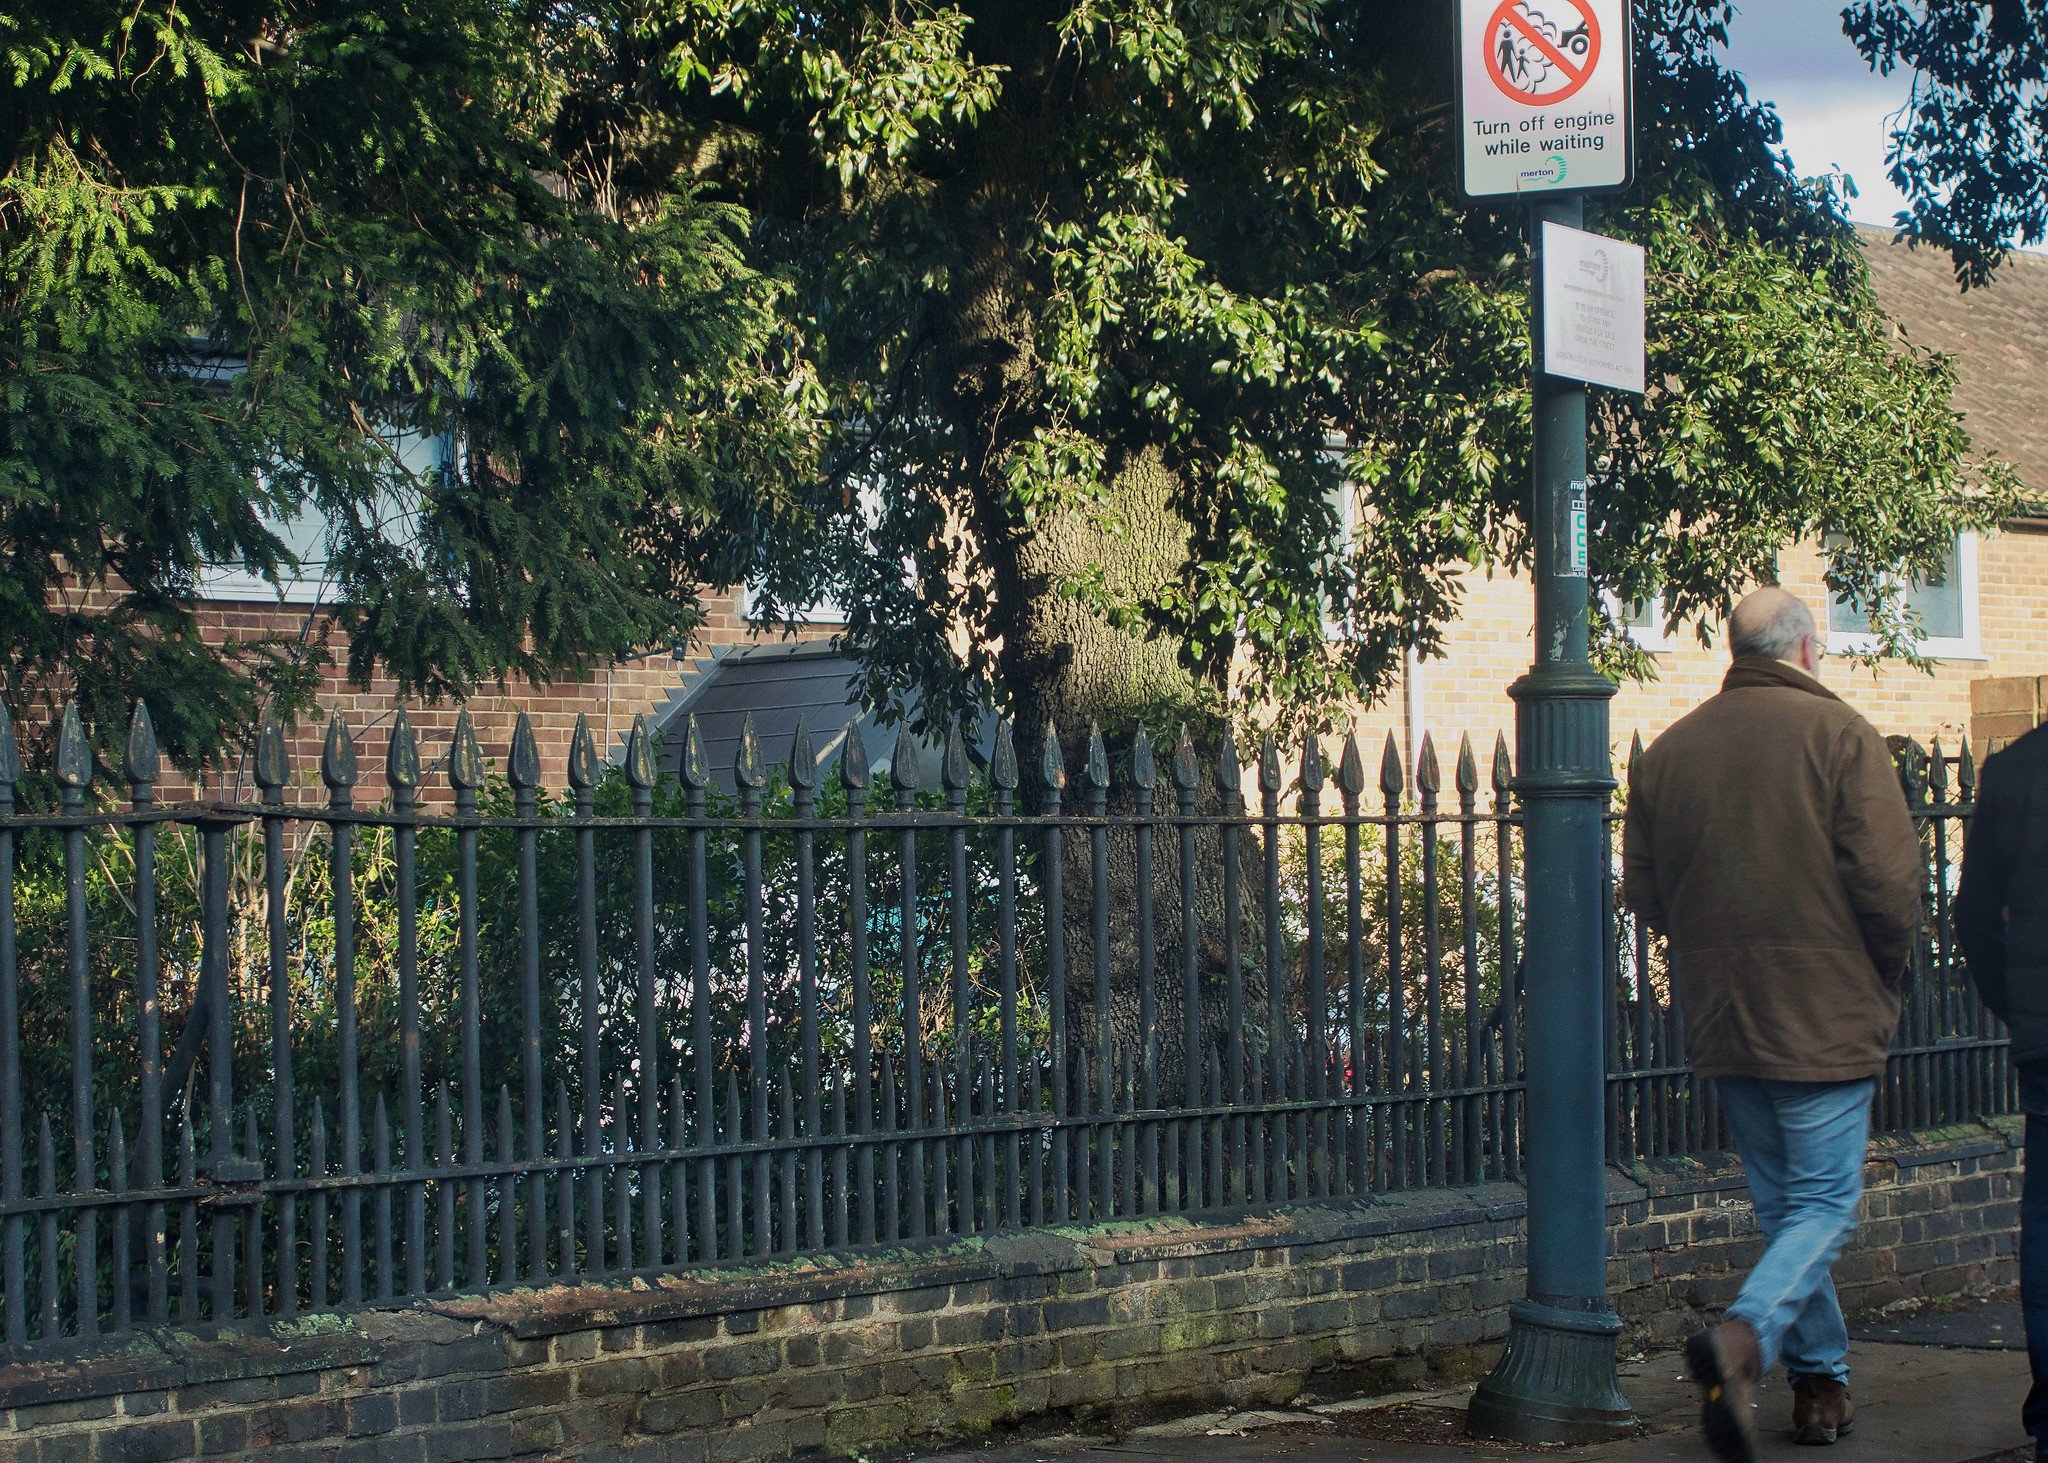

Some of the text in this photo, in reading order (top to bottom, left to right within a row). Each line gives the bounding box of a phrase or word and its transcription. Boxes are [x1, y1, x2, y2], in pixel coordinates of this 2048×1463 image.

[1473, 111, 1615, 135] Turn off engine
[1485, 134, 1604, 155] while waiting
[1520, 168, 1554, 178] merton
[1579, 260, 1601, 271] merton
[1587, 304, 1594, 313] AN
[1595, 306, 1614, 319] OFFENCE
[1580, 314, 1611, 328] TO OFFER ANY
[1576, 324, 1615, 340] VEHICLE FOR SALE
[1576, 335, 1615, 351] FROM THE STREET
[1556, 350, 1573, 362] LONDON
[1589, 358, 1614, 370] AUTHORITIES
[1615, 364, 1623, 372] ACT
